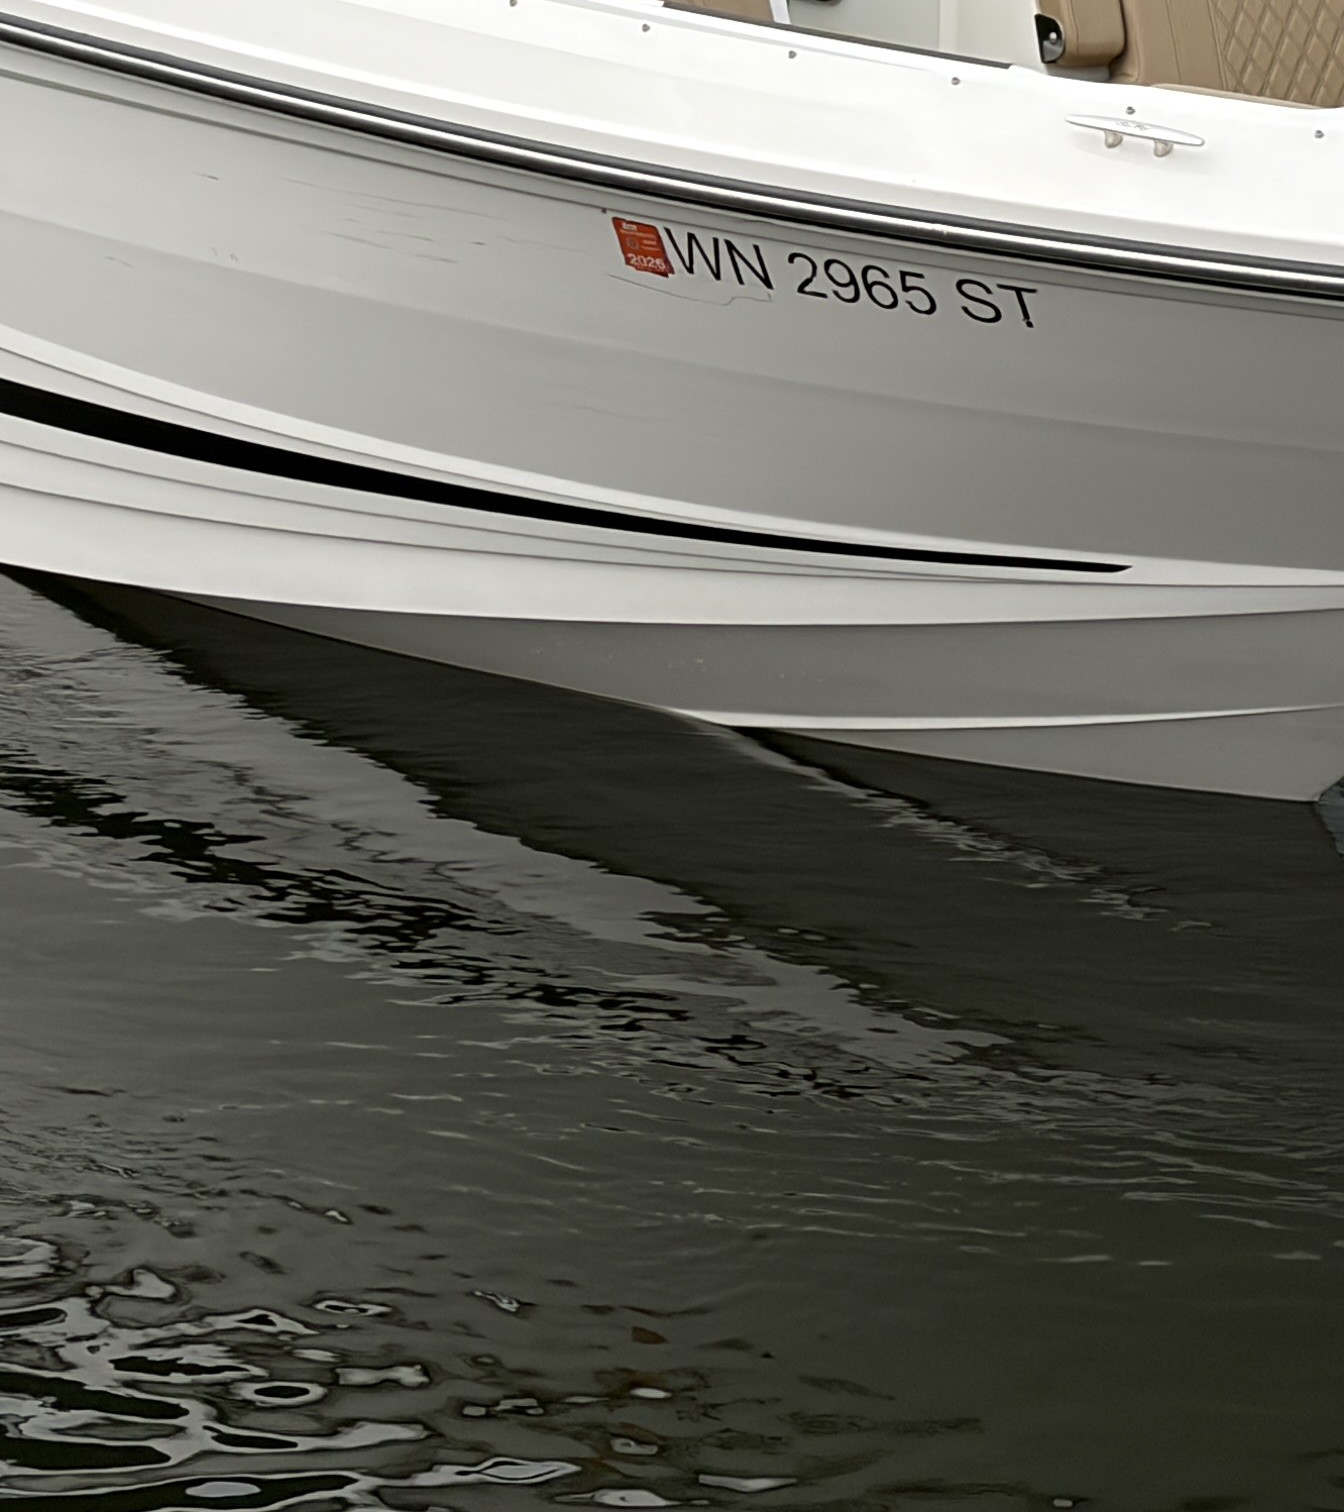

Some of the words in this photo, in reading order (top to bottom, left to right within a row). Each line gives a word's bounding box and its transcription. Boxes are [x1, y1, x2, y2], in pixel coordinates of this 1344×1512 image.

[663, 226, 774, 290] WN
[788, 252, 937, 316] 2965
[956, 279, 1038, 329] ST
